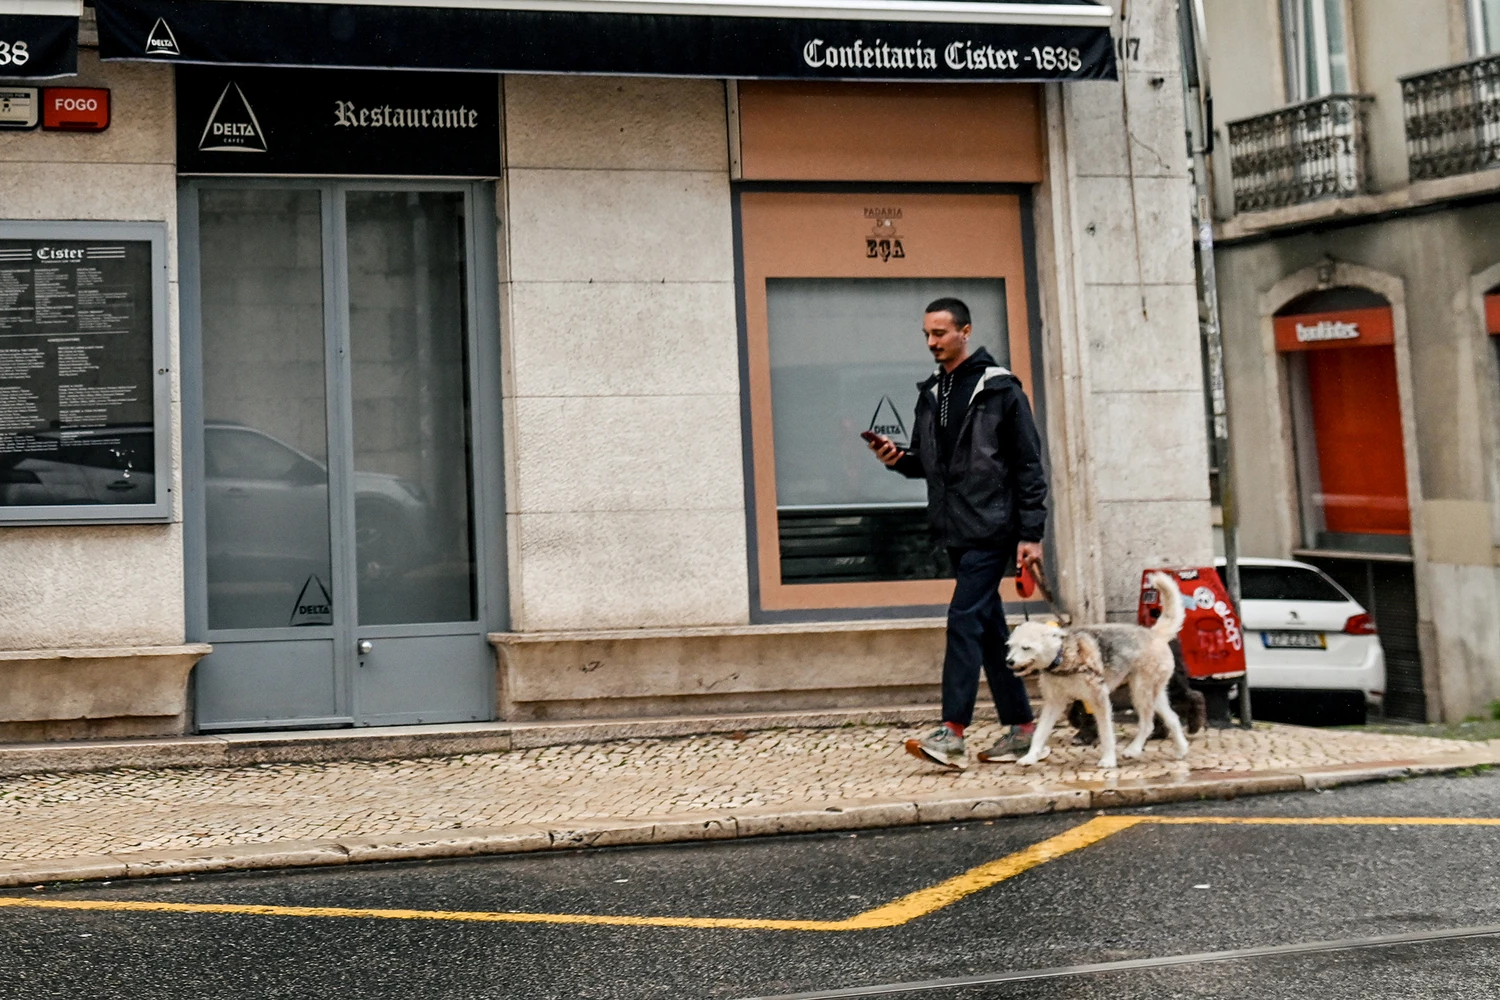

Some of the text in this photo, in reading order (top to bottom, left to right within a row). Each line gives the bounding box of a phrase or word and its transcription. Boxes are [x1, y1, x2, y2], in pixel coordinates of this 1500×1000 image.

[151, 39, 173, 47] DELTA
[803, 38, 937, 70] Confeitaria
[945, 39, 1019, 71] Cister
[55, 98, 98, 111] FOGO
[334, 100, 479, 129] Restaurante
[213, 122, 256, 136] DELTA
[863, 207, 903, 217] PADARIA
[36, 246, 85, 260] Cister
[866, 239, 905, 263] EÇA
[874, 425, 901, 435] DELTA
[299, 605, 330, 615] DELTA
